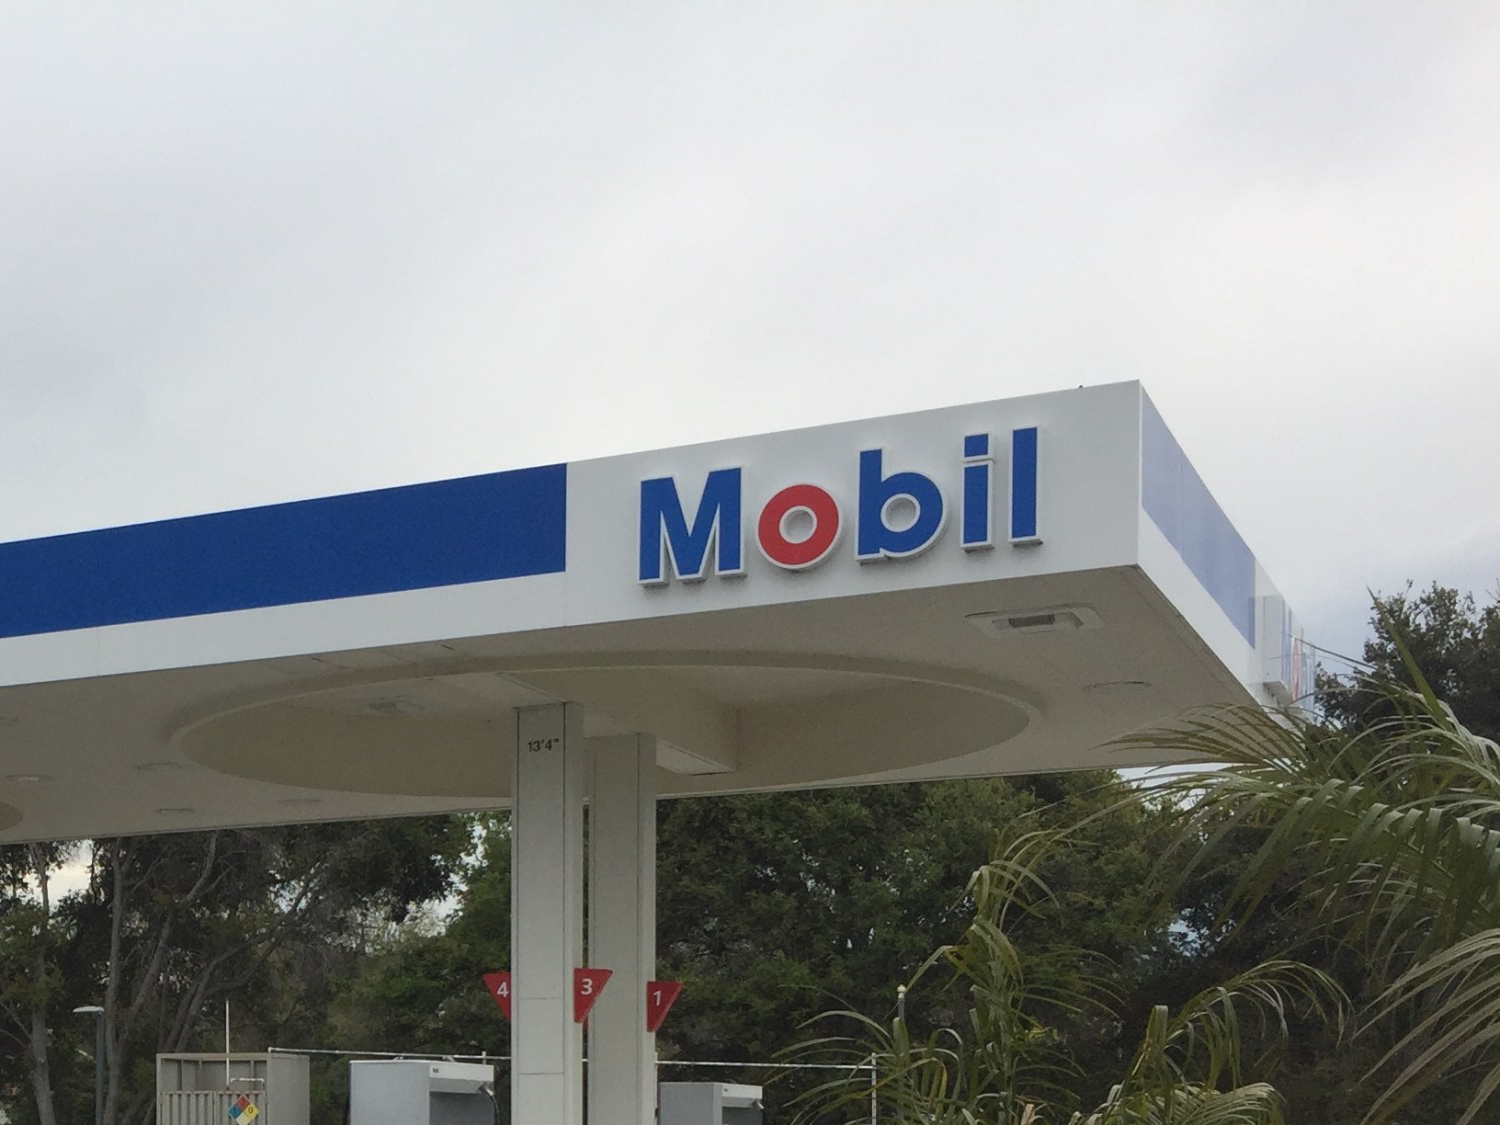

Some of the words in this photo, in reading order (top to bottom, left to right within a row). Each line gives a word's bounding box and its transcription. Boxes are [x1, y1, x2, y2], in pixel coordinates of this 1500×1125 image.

[637, 425, 1043, 586] Mobil
[497, 982, 509, 998] 4
[580, 978, 593, 995] 3
[653, 990, 662, 1006] 1
